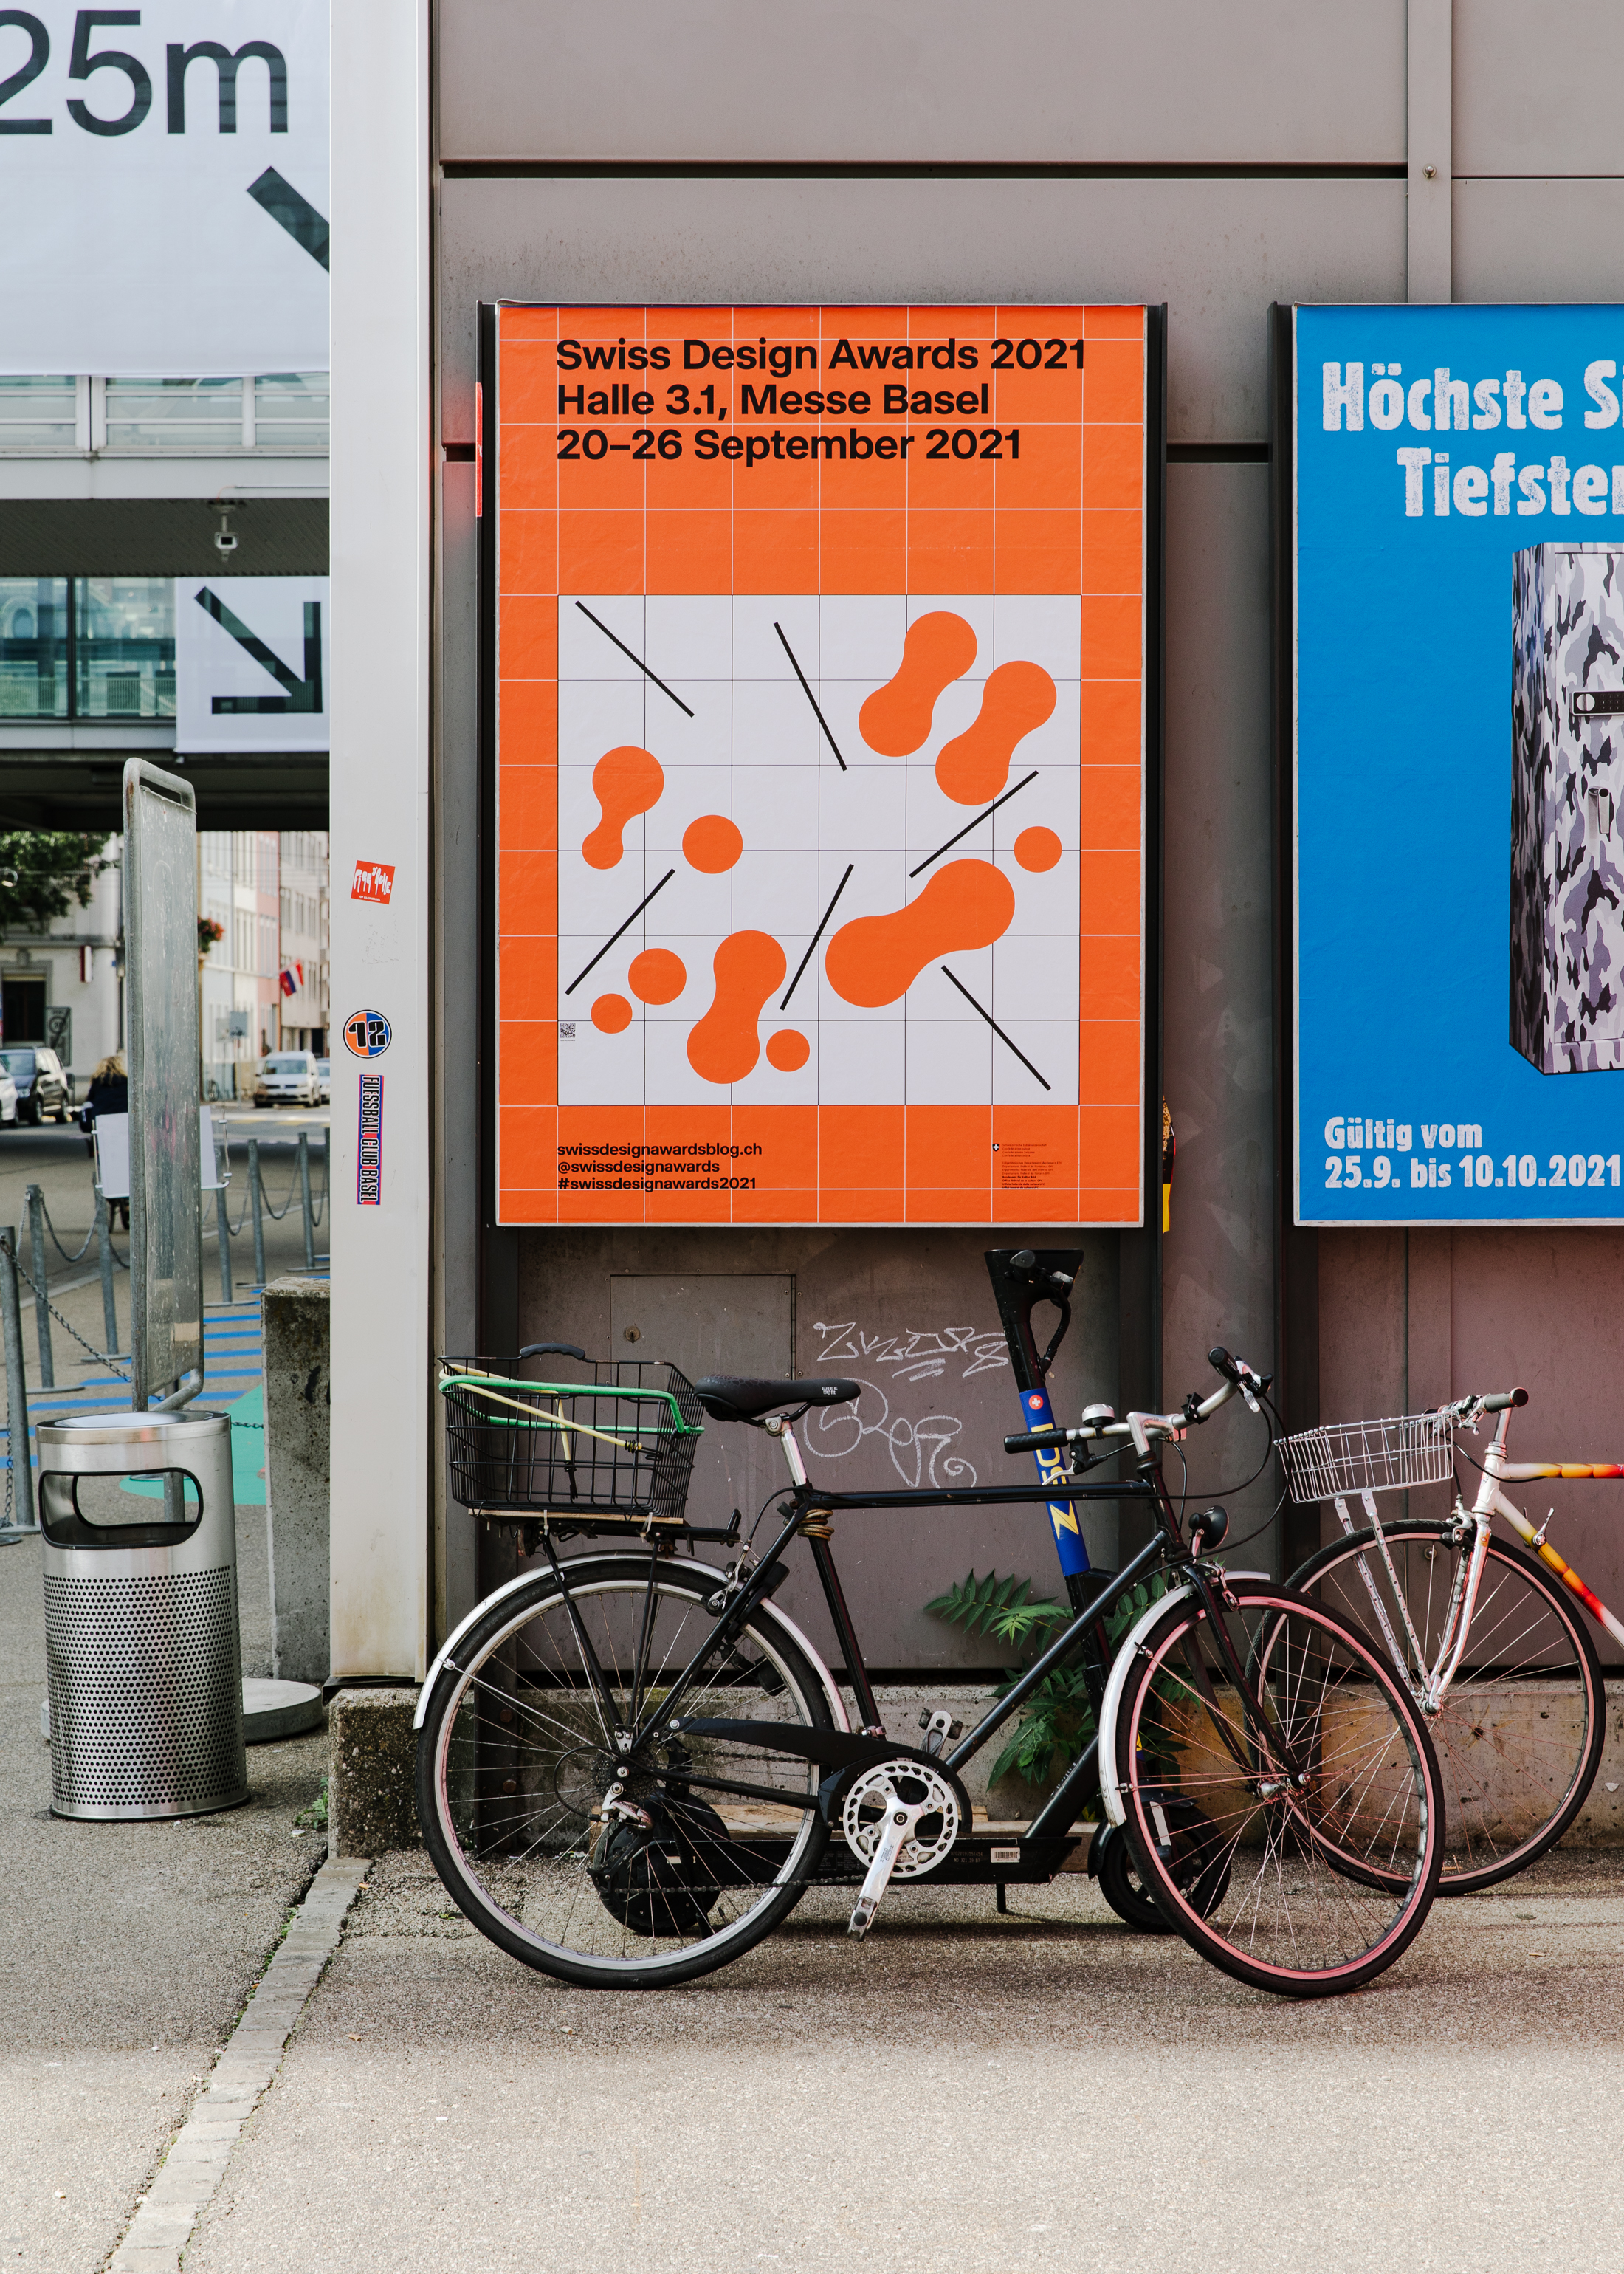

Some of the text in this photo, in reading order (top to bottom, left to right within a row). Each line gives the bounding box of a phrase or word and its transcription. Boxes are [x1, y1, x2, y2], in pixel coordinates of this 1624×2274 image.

[556, 338, 1084, 378] Swiss Design Awards 2021
[558, 383, 988, 421] Halle 3.1, Messe Basel
[1322, 360, 1624, 431] Höchste S
[557, 428, 1019, 467] 20–26 September 2021
[348, 1020, 387, 1048] 12
[359, 1076, 380, 1203] FUESSBALL CLUB BASEL
[557, 1142, 763, 1158] swissdesignawardsblog.ch
[1324, 1116, 1482, 1152] Gültig vom
[557, 1160, 720, 1175] @swissdesignawards
[557, 1177, 757, 1193] #swissdesignawards2021
[1324, 1153, 1621, 1189] 25.9. bis 10.10.2021
